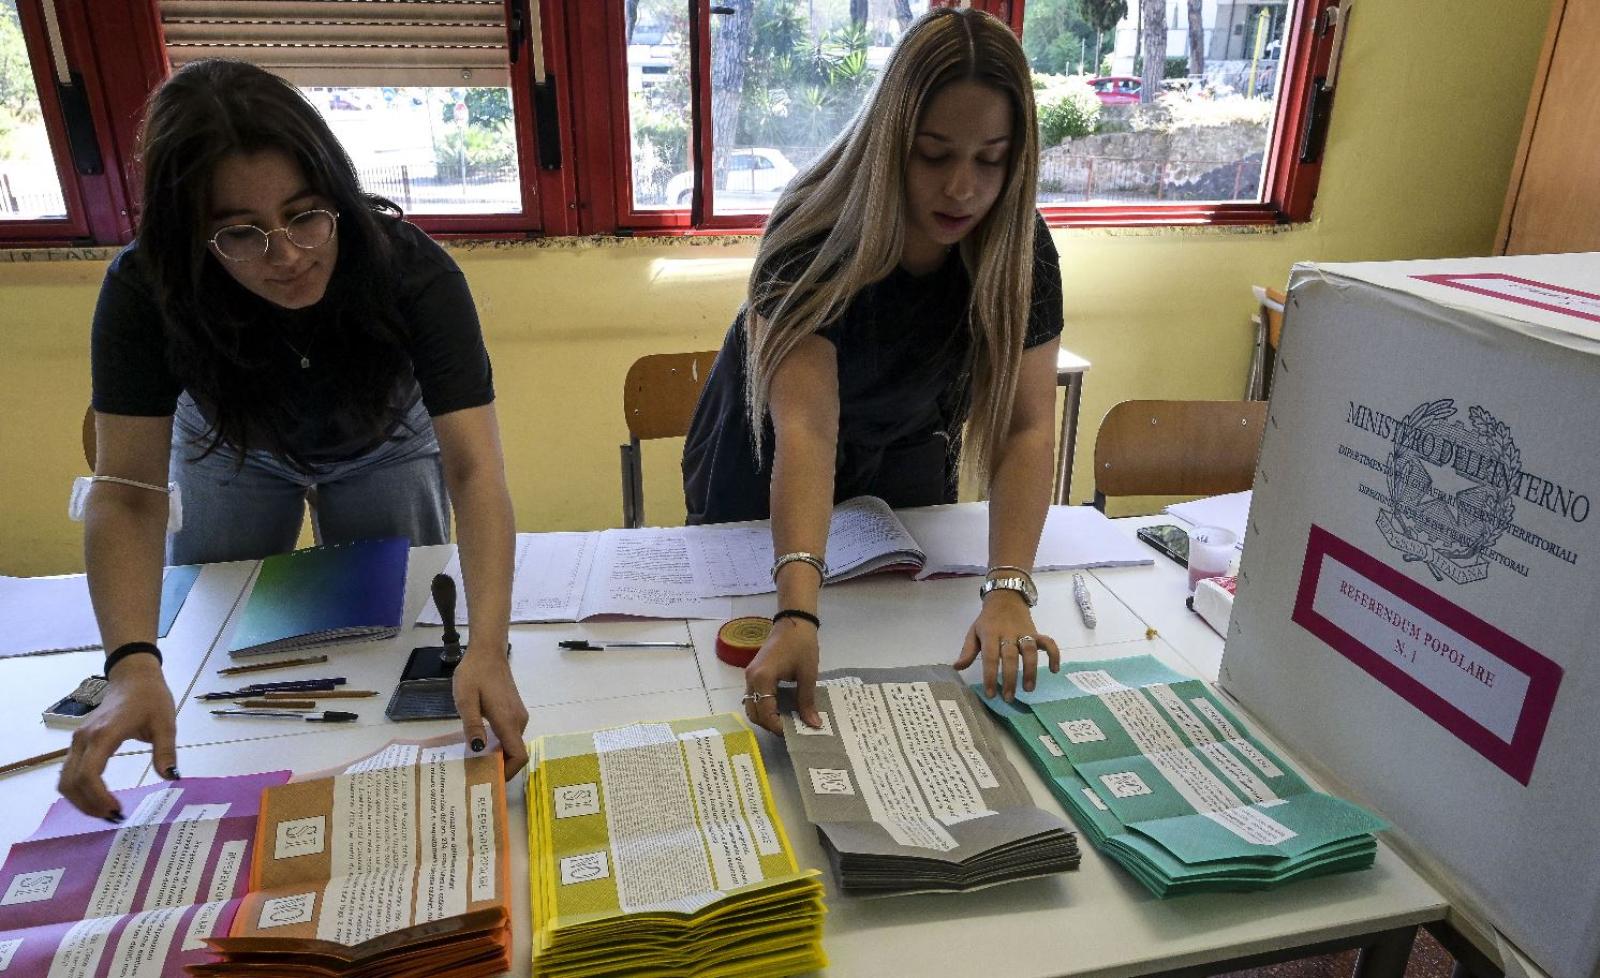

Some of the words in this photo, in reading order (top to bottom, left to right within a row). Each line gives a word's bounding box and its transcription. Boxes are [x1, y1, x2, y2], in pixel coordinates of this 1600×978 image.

[1346, 401, 1435, 458] MINISTERO
[1438, 436, 1590, 523] DELL'INTERNO
[1480, 545, 1530, 578] ELETTORALI
[1506, 522, 1578, 565] TERRITORIALI
[1339, 580, 1421, 641] REFERENDUM
[1423, 633, 1496, 688] POPOLARE
